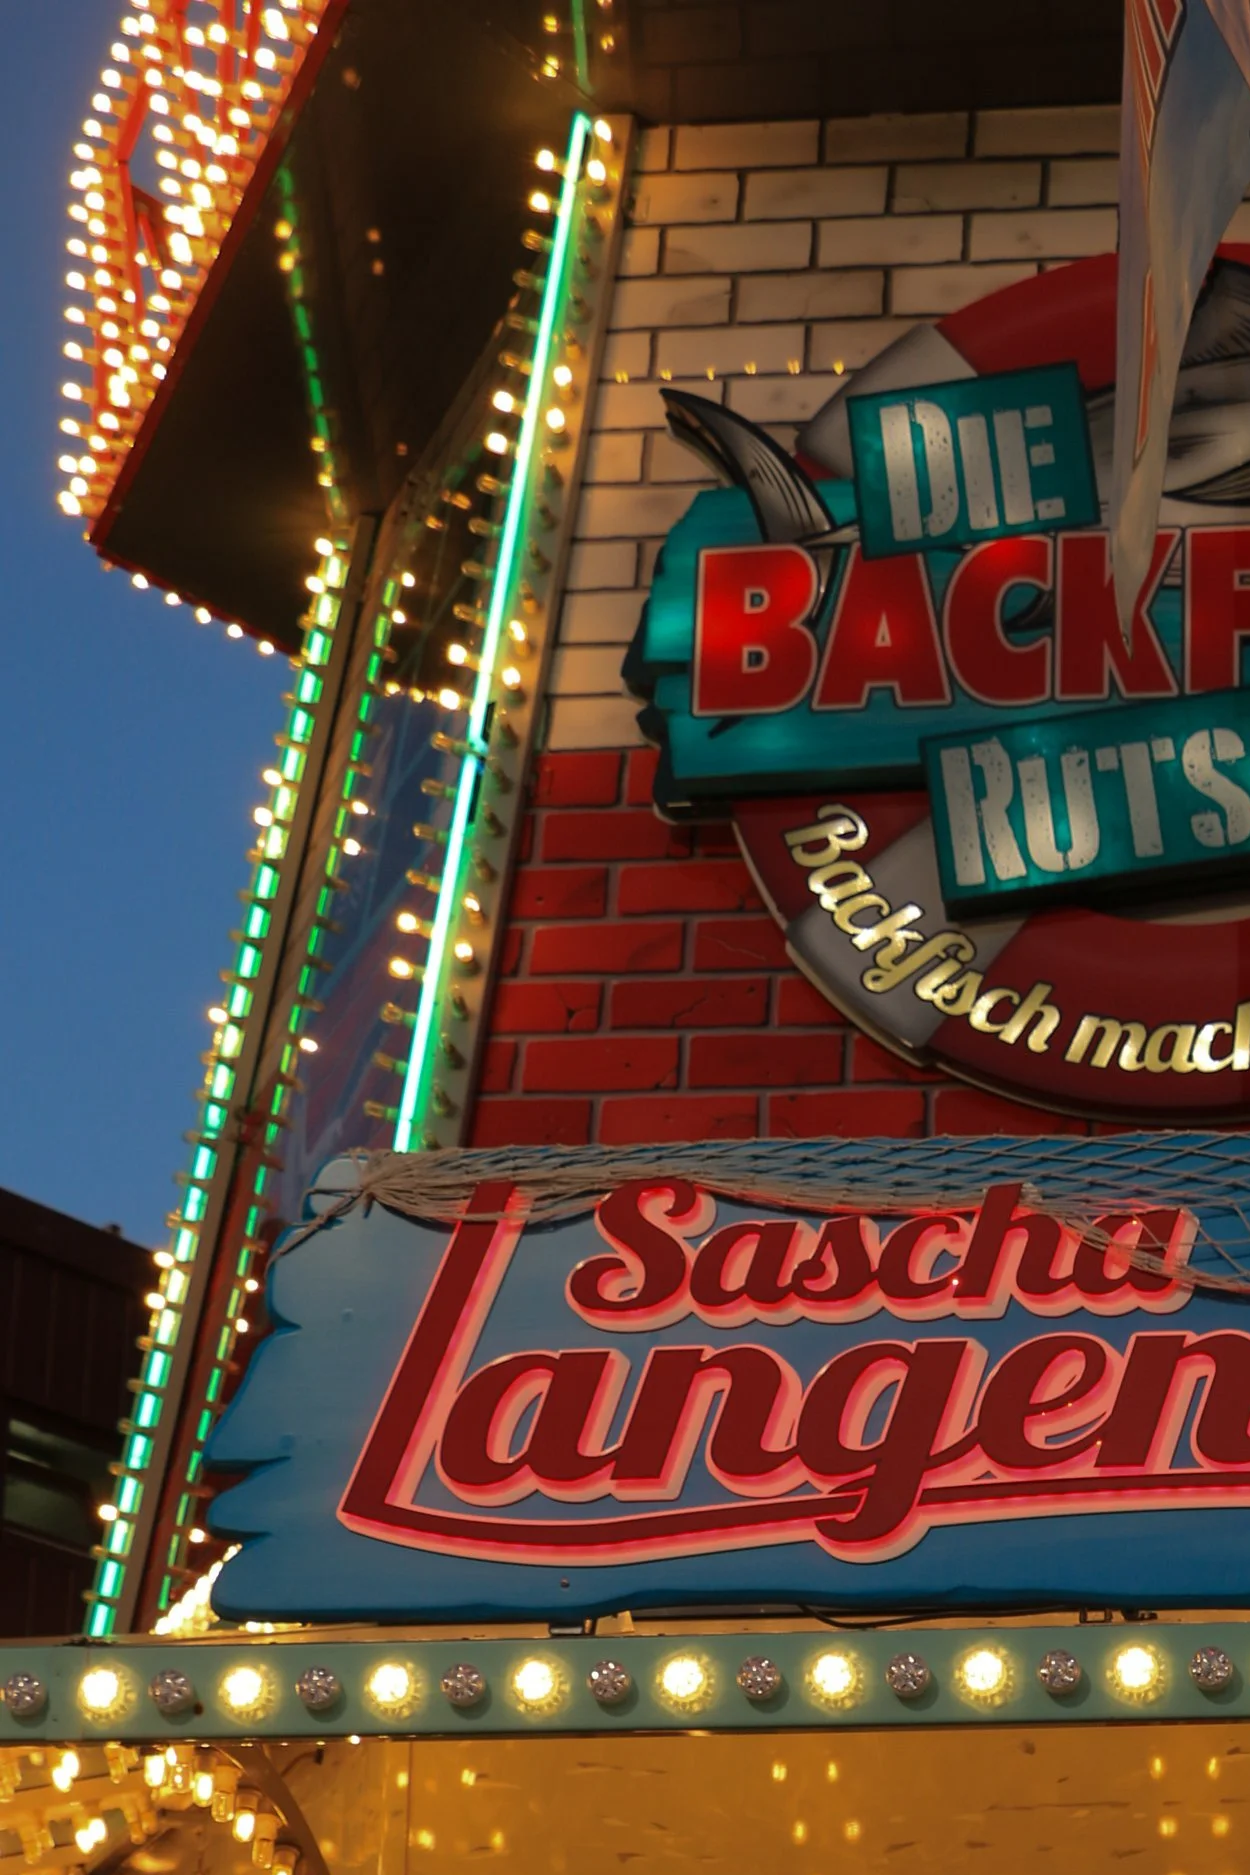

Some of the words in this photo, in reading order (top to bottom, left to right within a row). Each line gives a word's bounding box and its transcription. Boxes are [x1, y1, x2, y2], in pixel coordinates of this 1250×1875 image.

[879, 396, 1067, 542] DIE
[784, 802, 1060, 1055] Backfisch
[566, 1178, 1199, 1326] Sascha
